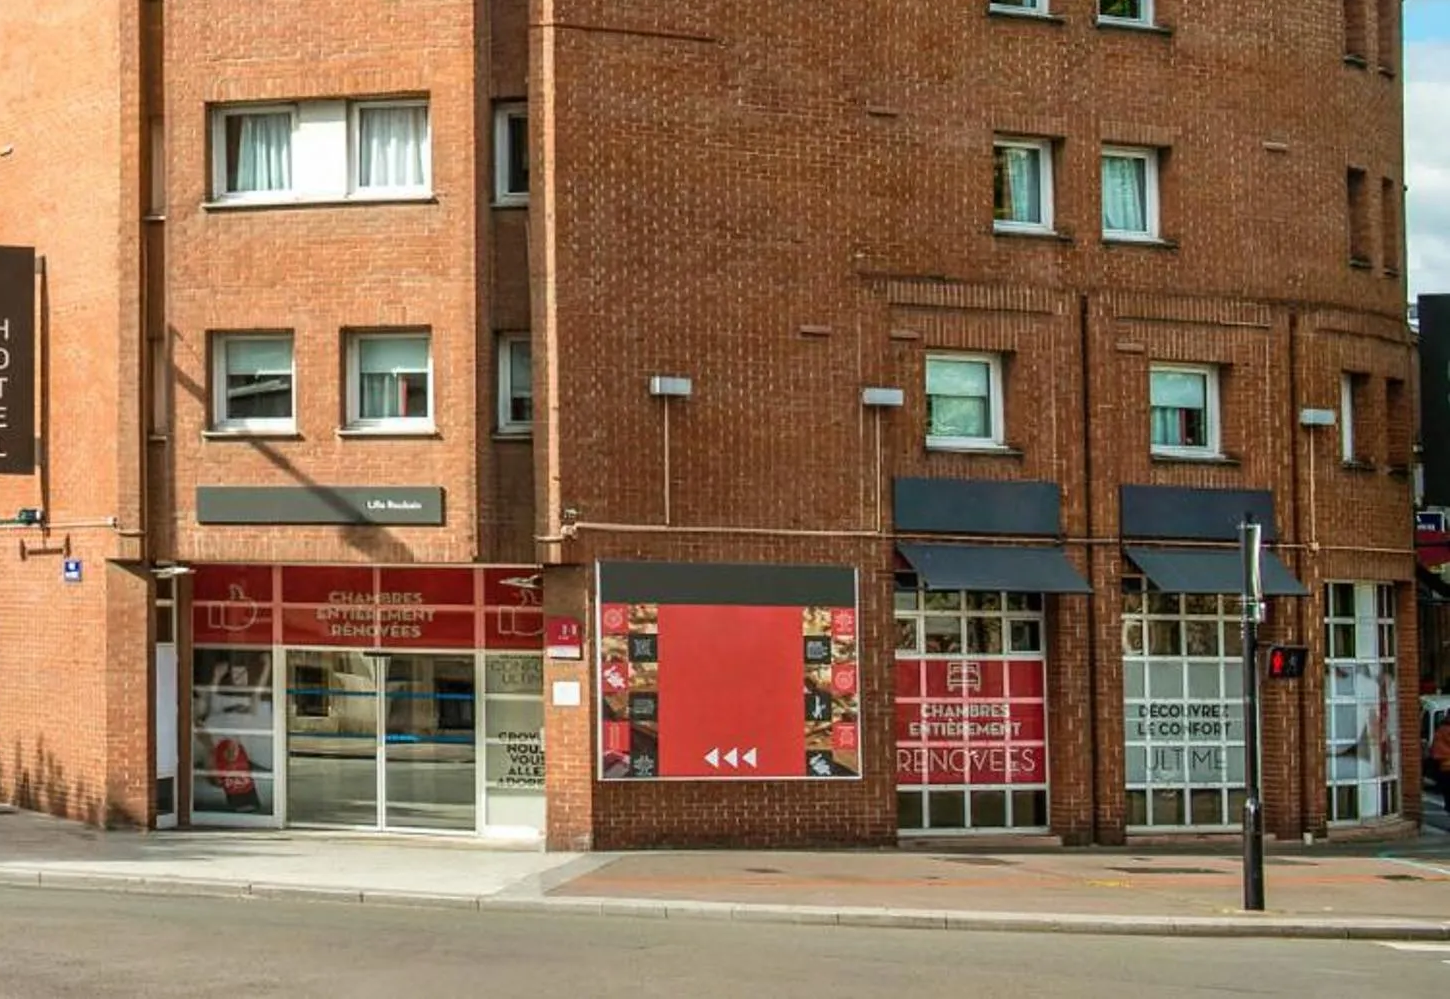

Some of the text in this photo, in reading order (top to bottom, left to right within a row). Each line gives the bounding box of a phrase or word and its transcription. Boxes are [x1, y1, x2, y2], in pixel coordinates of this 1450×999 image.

[328, 591, 423, 604] CHAMBRES
[921, 703, 1009, 718] CHAMBRES
[1138, 721, 1155, 736] LE
[1143, 748, 1230, 771] ULTME
